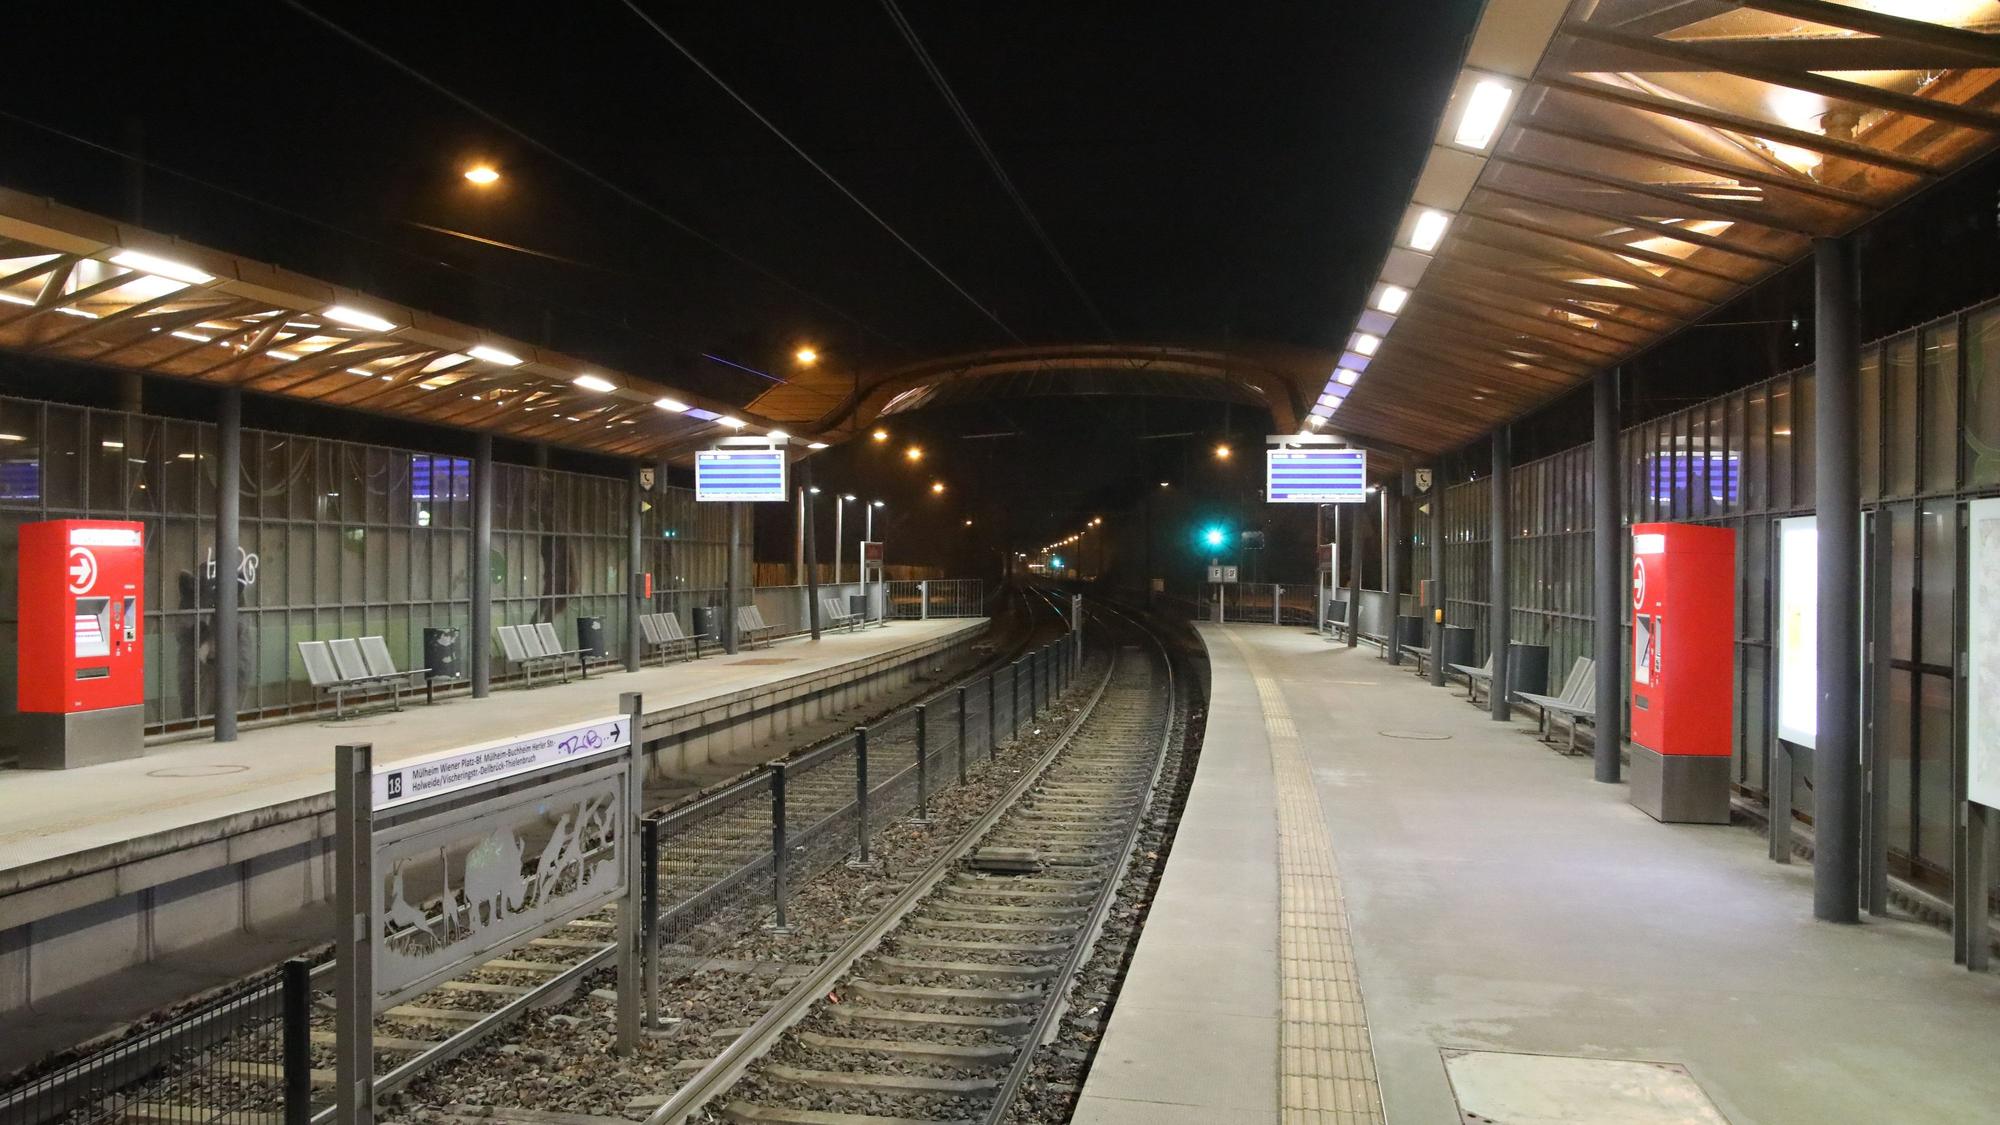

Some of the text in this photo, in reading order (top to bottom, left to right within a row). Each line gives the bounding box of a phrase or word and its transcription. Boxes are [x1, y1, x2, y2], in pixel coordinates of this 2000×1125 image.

[412, 765, 439, 779] Mülheim
[440, 763, 460, 773] Wiener
[389, 777, 402, 795] 18
